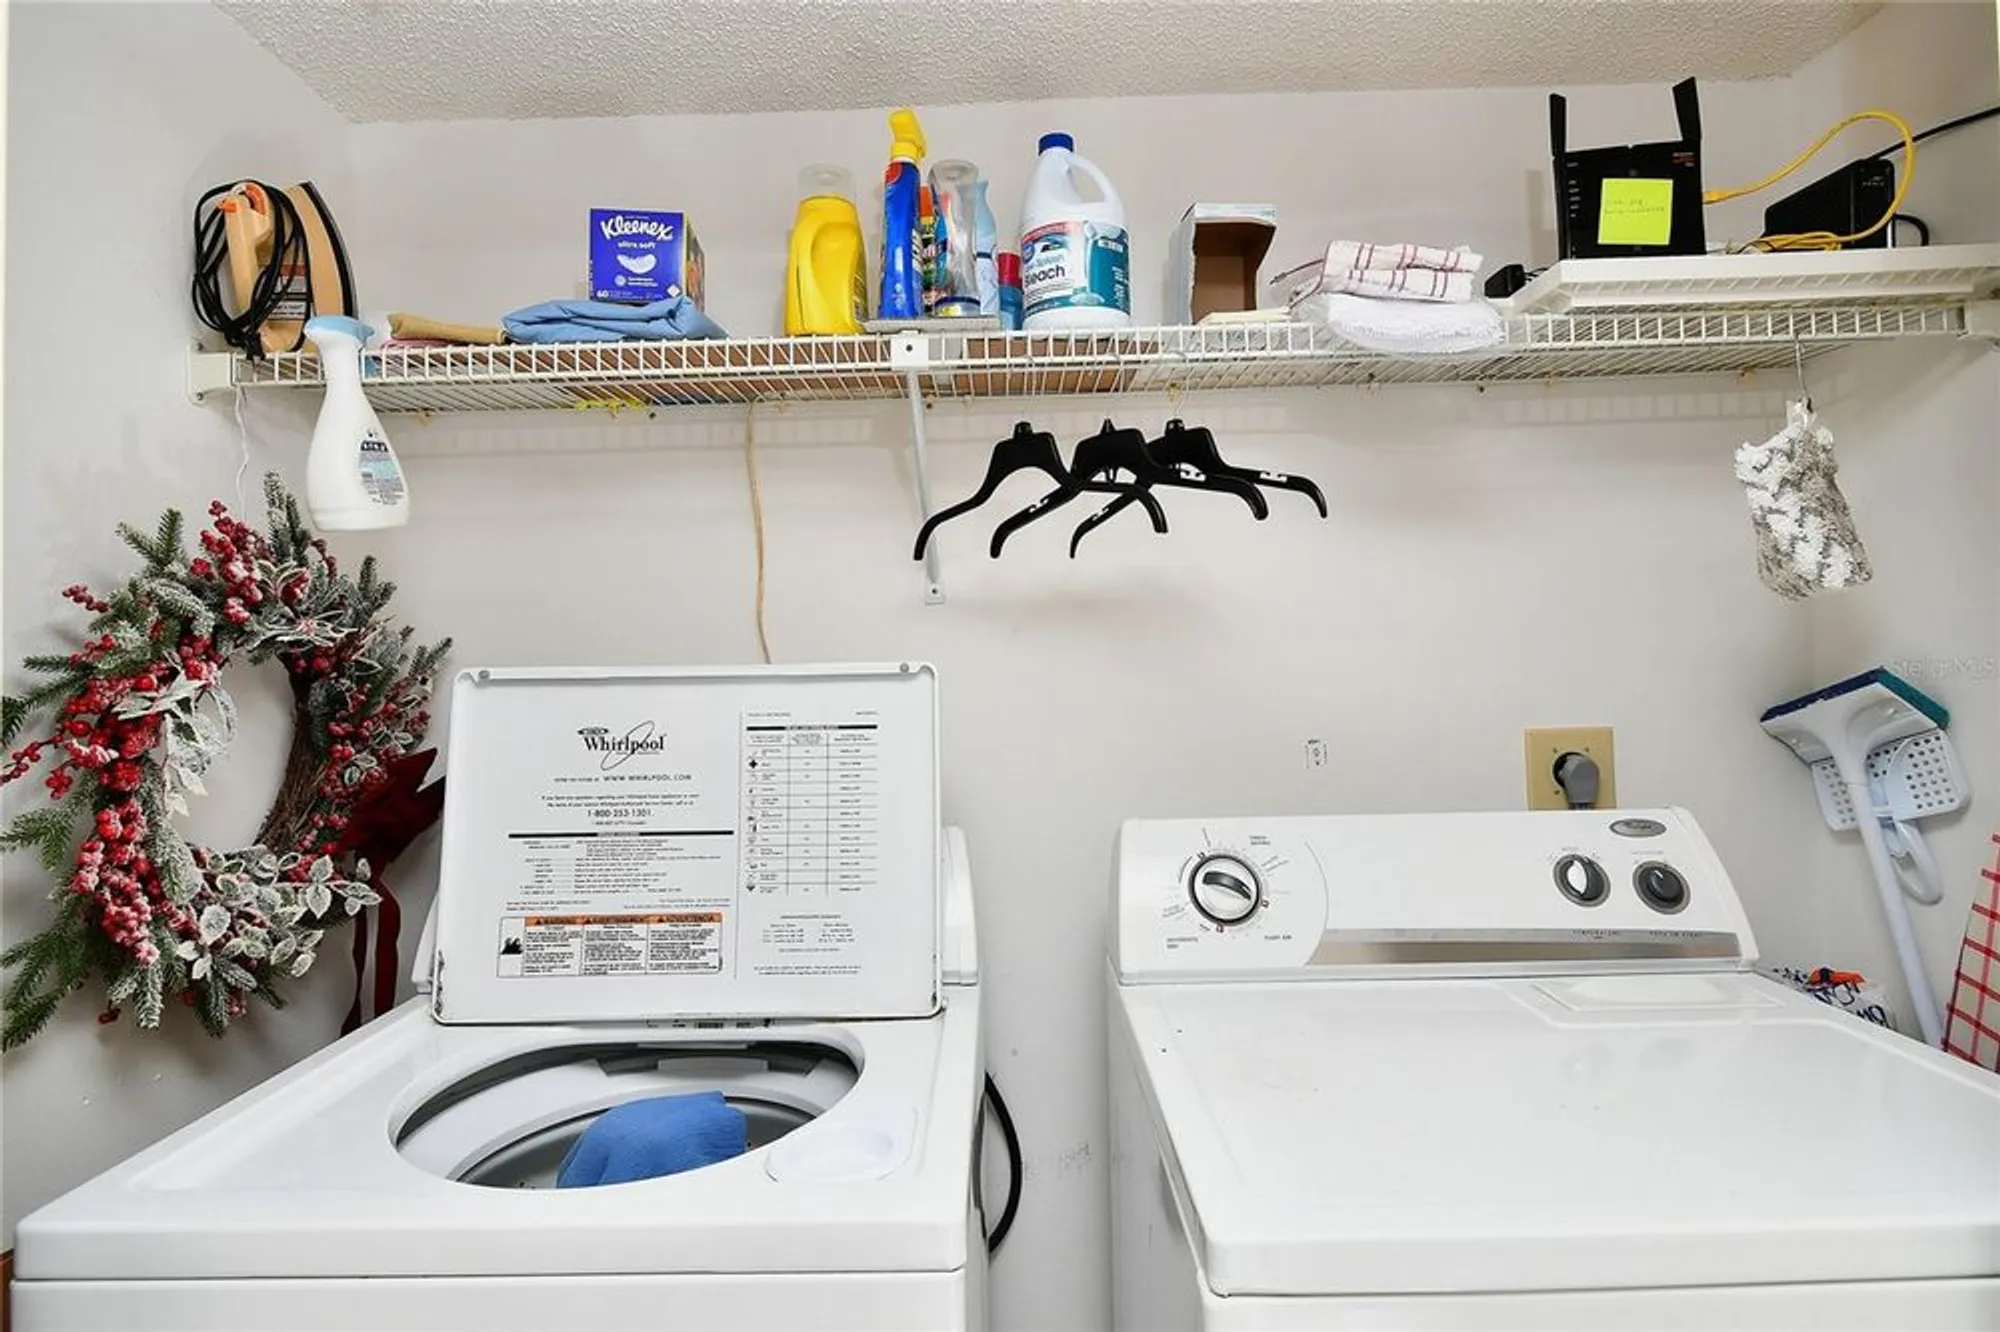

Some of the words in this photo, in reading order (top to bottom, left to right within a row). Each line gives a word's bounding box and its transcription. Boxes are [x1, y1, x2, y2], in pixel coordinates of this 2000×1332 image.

[600, 215, 673, 241] Kleenex
[617, 241, 637, 249] ultra
[639, 241, 656, 249] soft
[583, 735, 665, 755] Whirlpool
